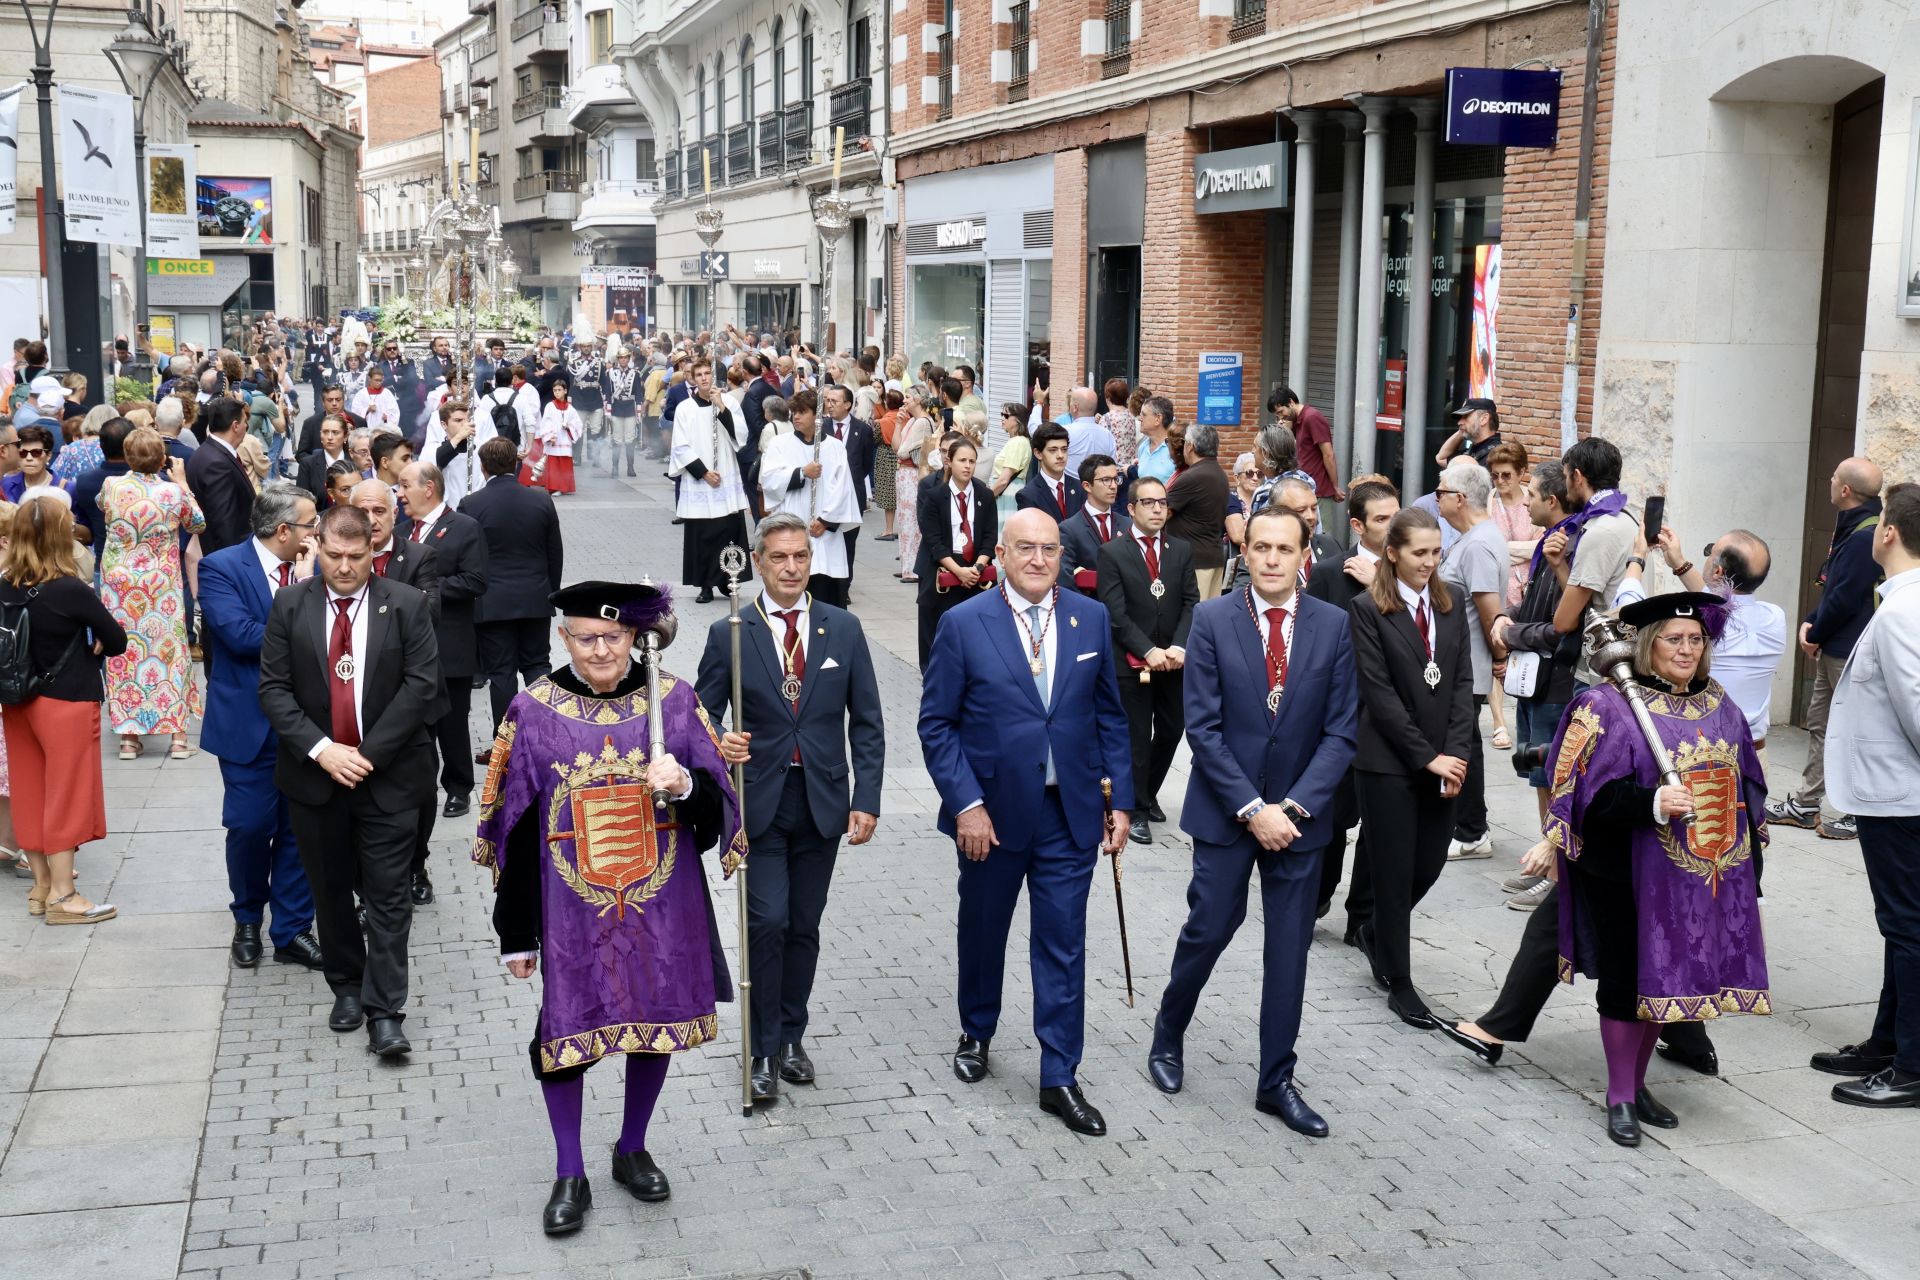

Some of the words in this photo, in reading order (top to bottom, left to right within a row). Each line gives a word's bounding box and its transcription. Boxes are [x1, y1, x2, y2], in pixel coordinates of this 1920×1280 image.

[1481, 101, 1550, 115] DECATHLON
[1210, 164, 1272, 193] DECATHLON
[68, 192, 90, 202] JUAN
[91, 195, 105, 204] DEL
[106, 197, 130, 208] JUNCO
[164, 262, 209, 273] ONCE
[607, 275, 646, 287] Mahou
